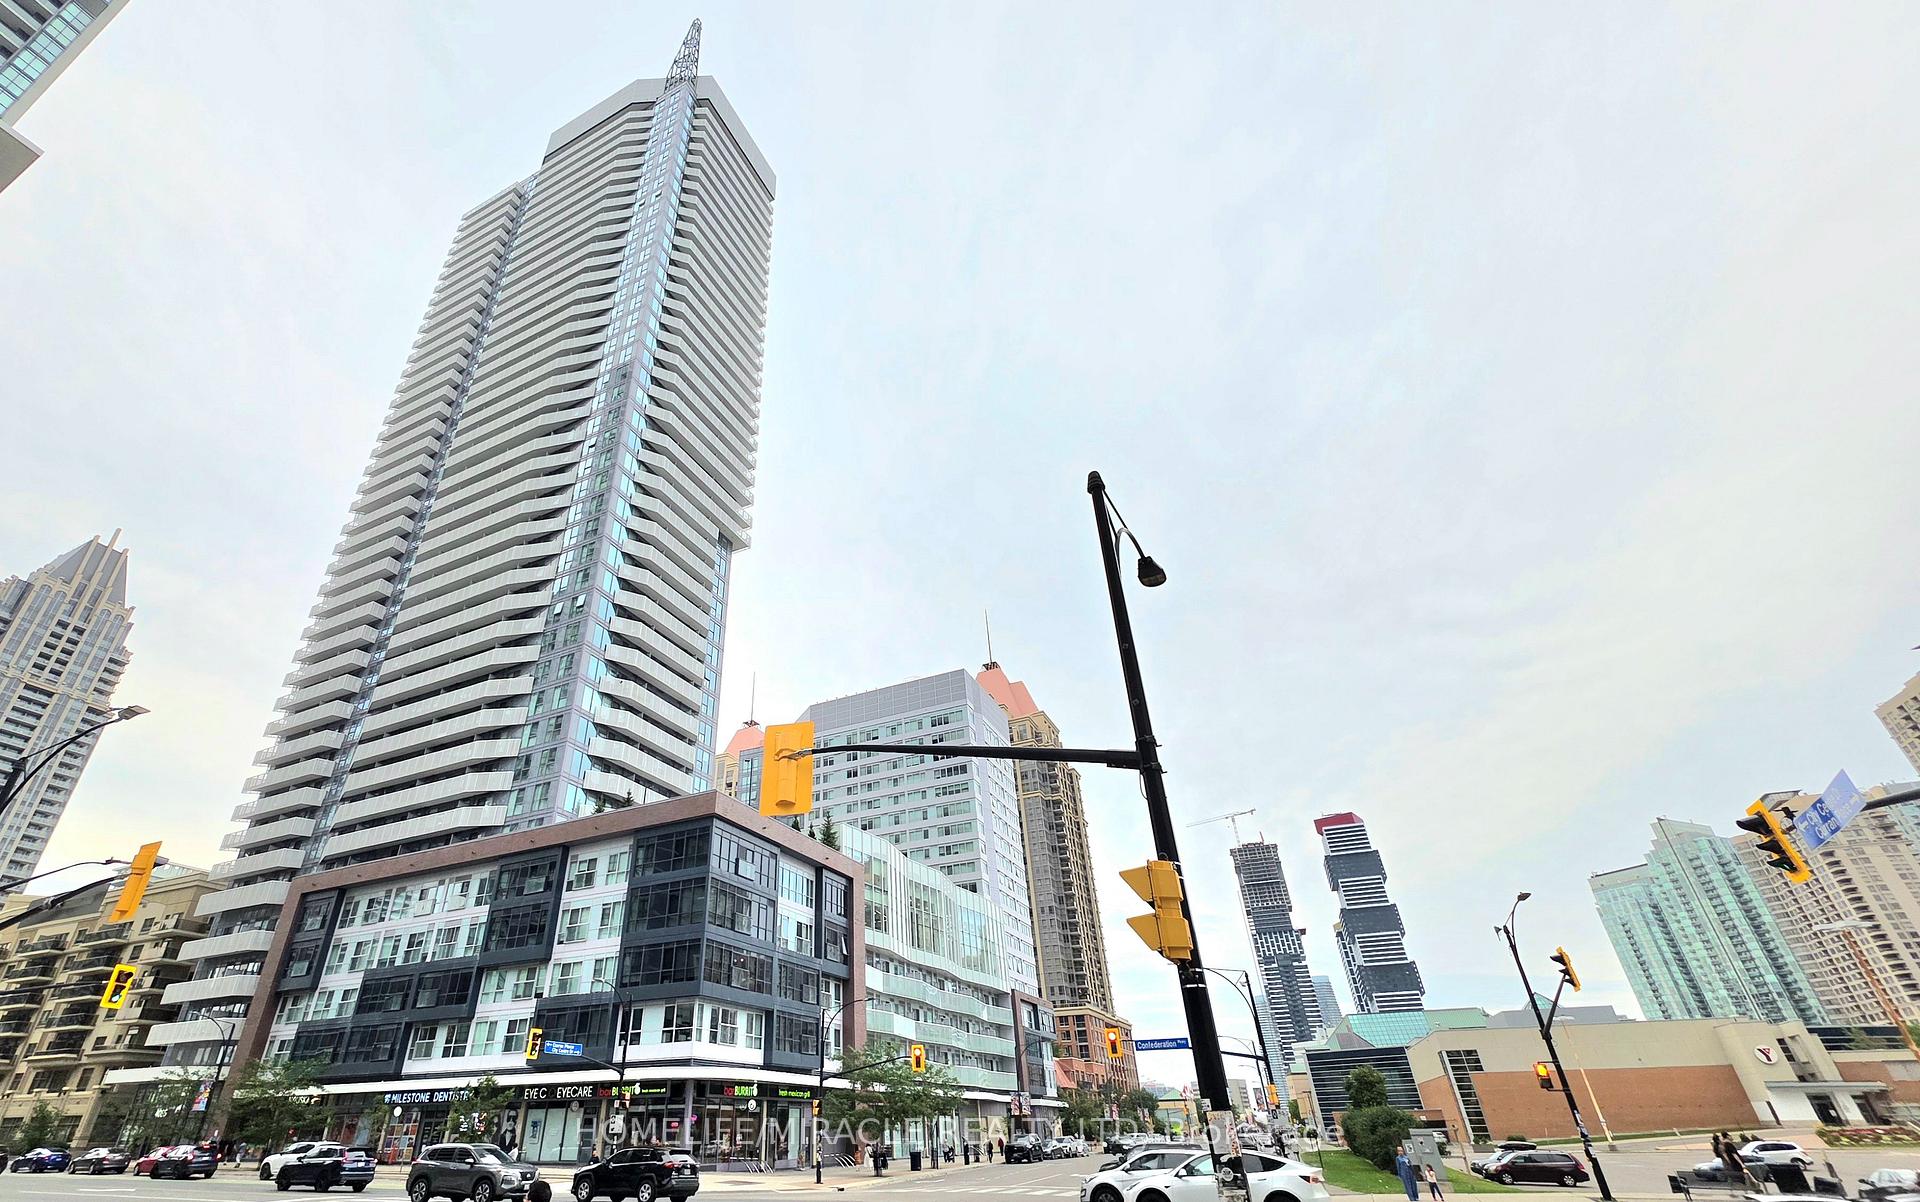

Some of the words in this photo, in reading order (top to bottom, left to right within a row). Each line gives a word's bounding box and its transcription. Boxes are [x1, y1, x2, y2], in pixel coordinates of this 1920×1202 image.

[1815, 816, 1839, 839] Curran
[1137, 1040, 1177, 1049] Confederation
[391, 1092, 431, 1104] MILESTONE
[557, 1085, 593, 1099] EYECARE
